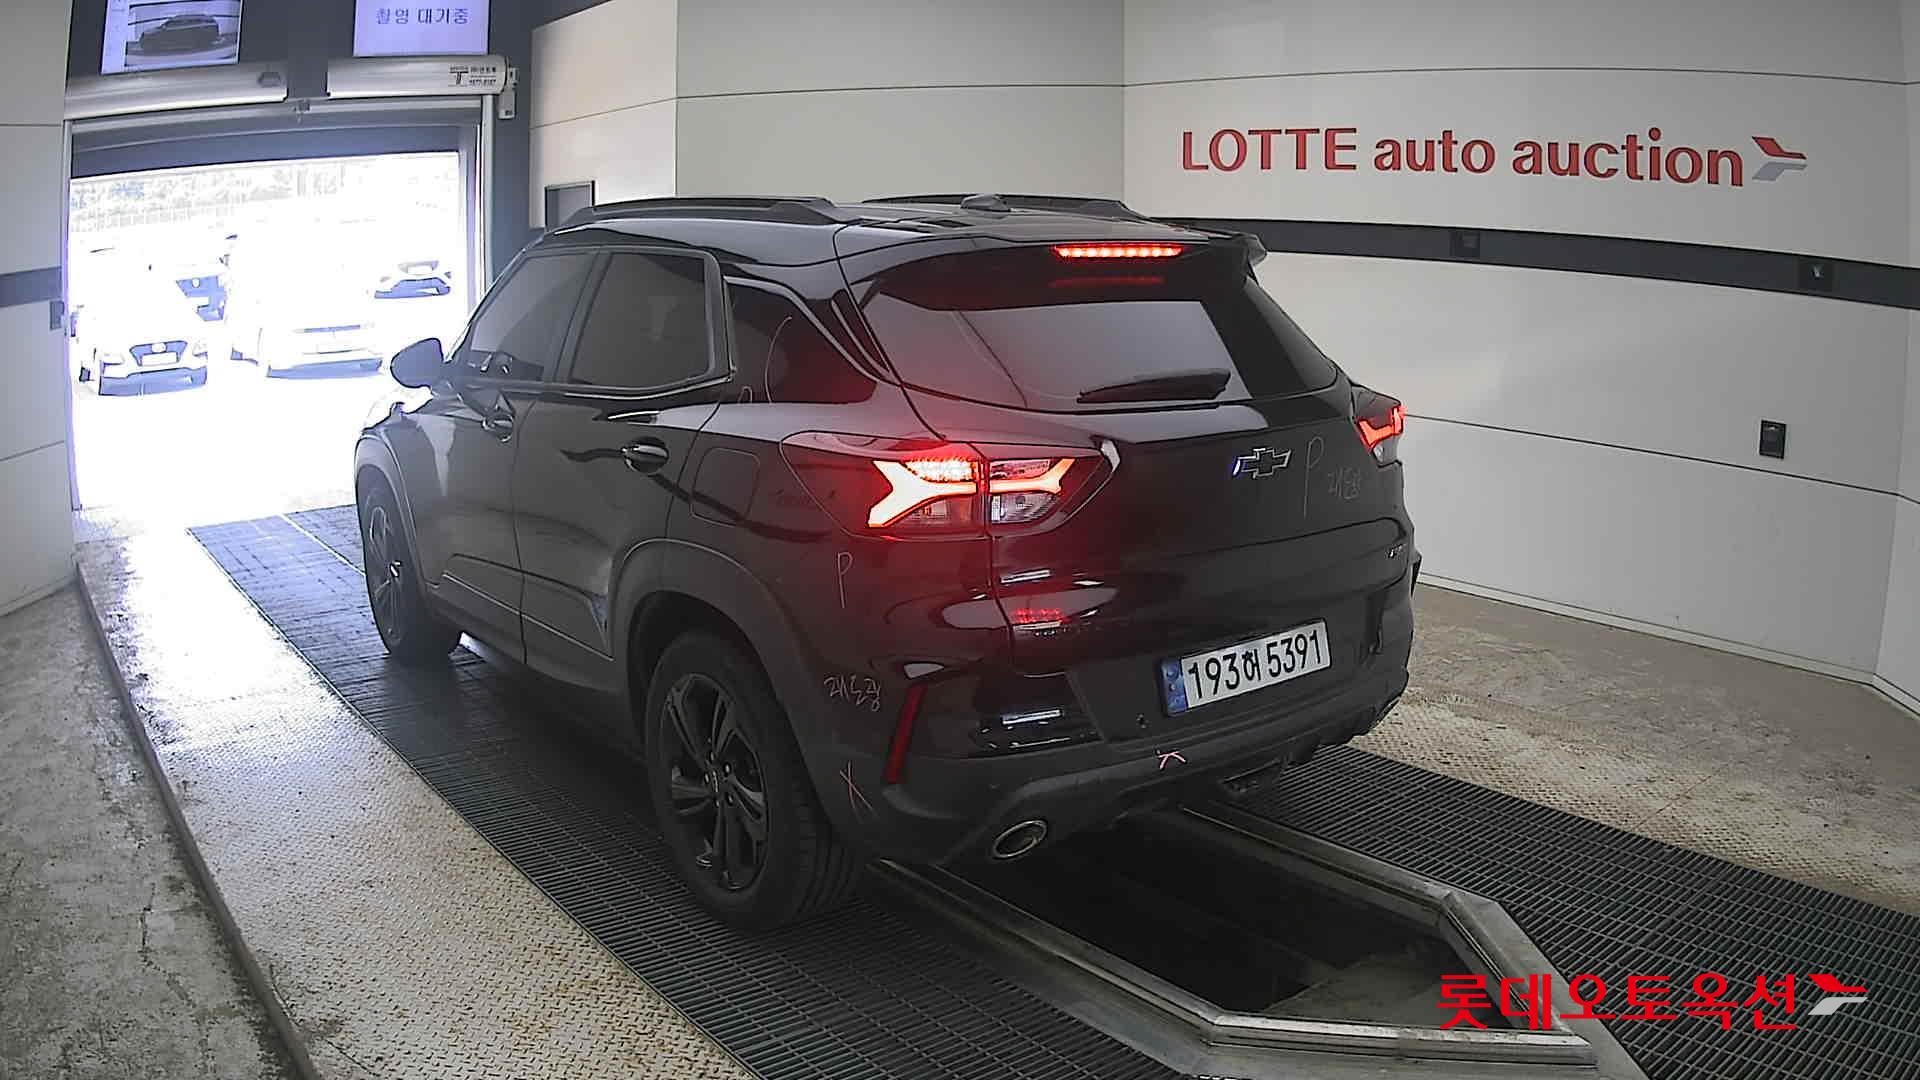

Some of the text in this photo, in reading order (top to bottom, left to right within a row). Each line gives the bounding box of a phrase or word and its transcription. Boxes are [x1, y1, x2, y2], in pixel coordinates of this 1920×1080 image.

[417, 7, 469, 25] 대기중
[1182, 127, 1743, 187] LOTTE auto auction
[1188, 629, 1321, 698] 193허 5391
